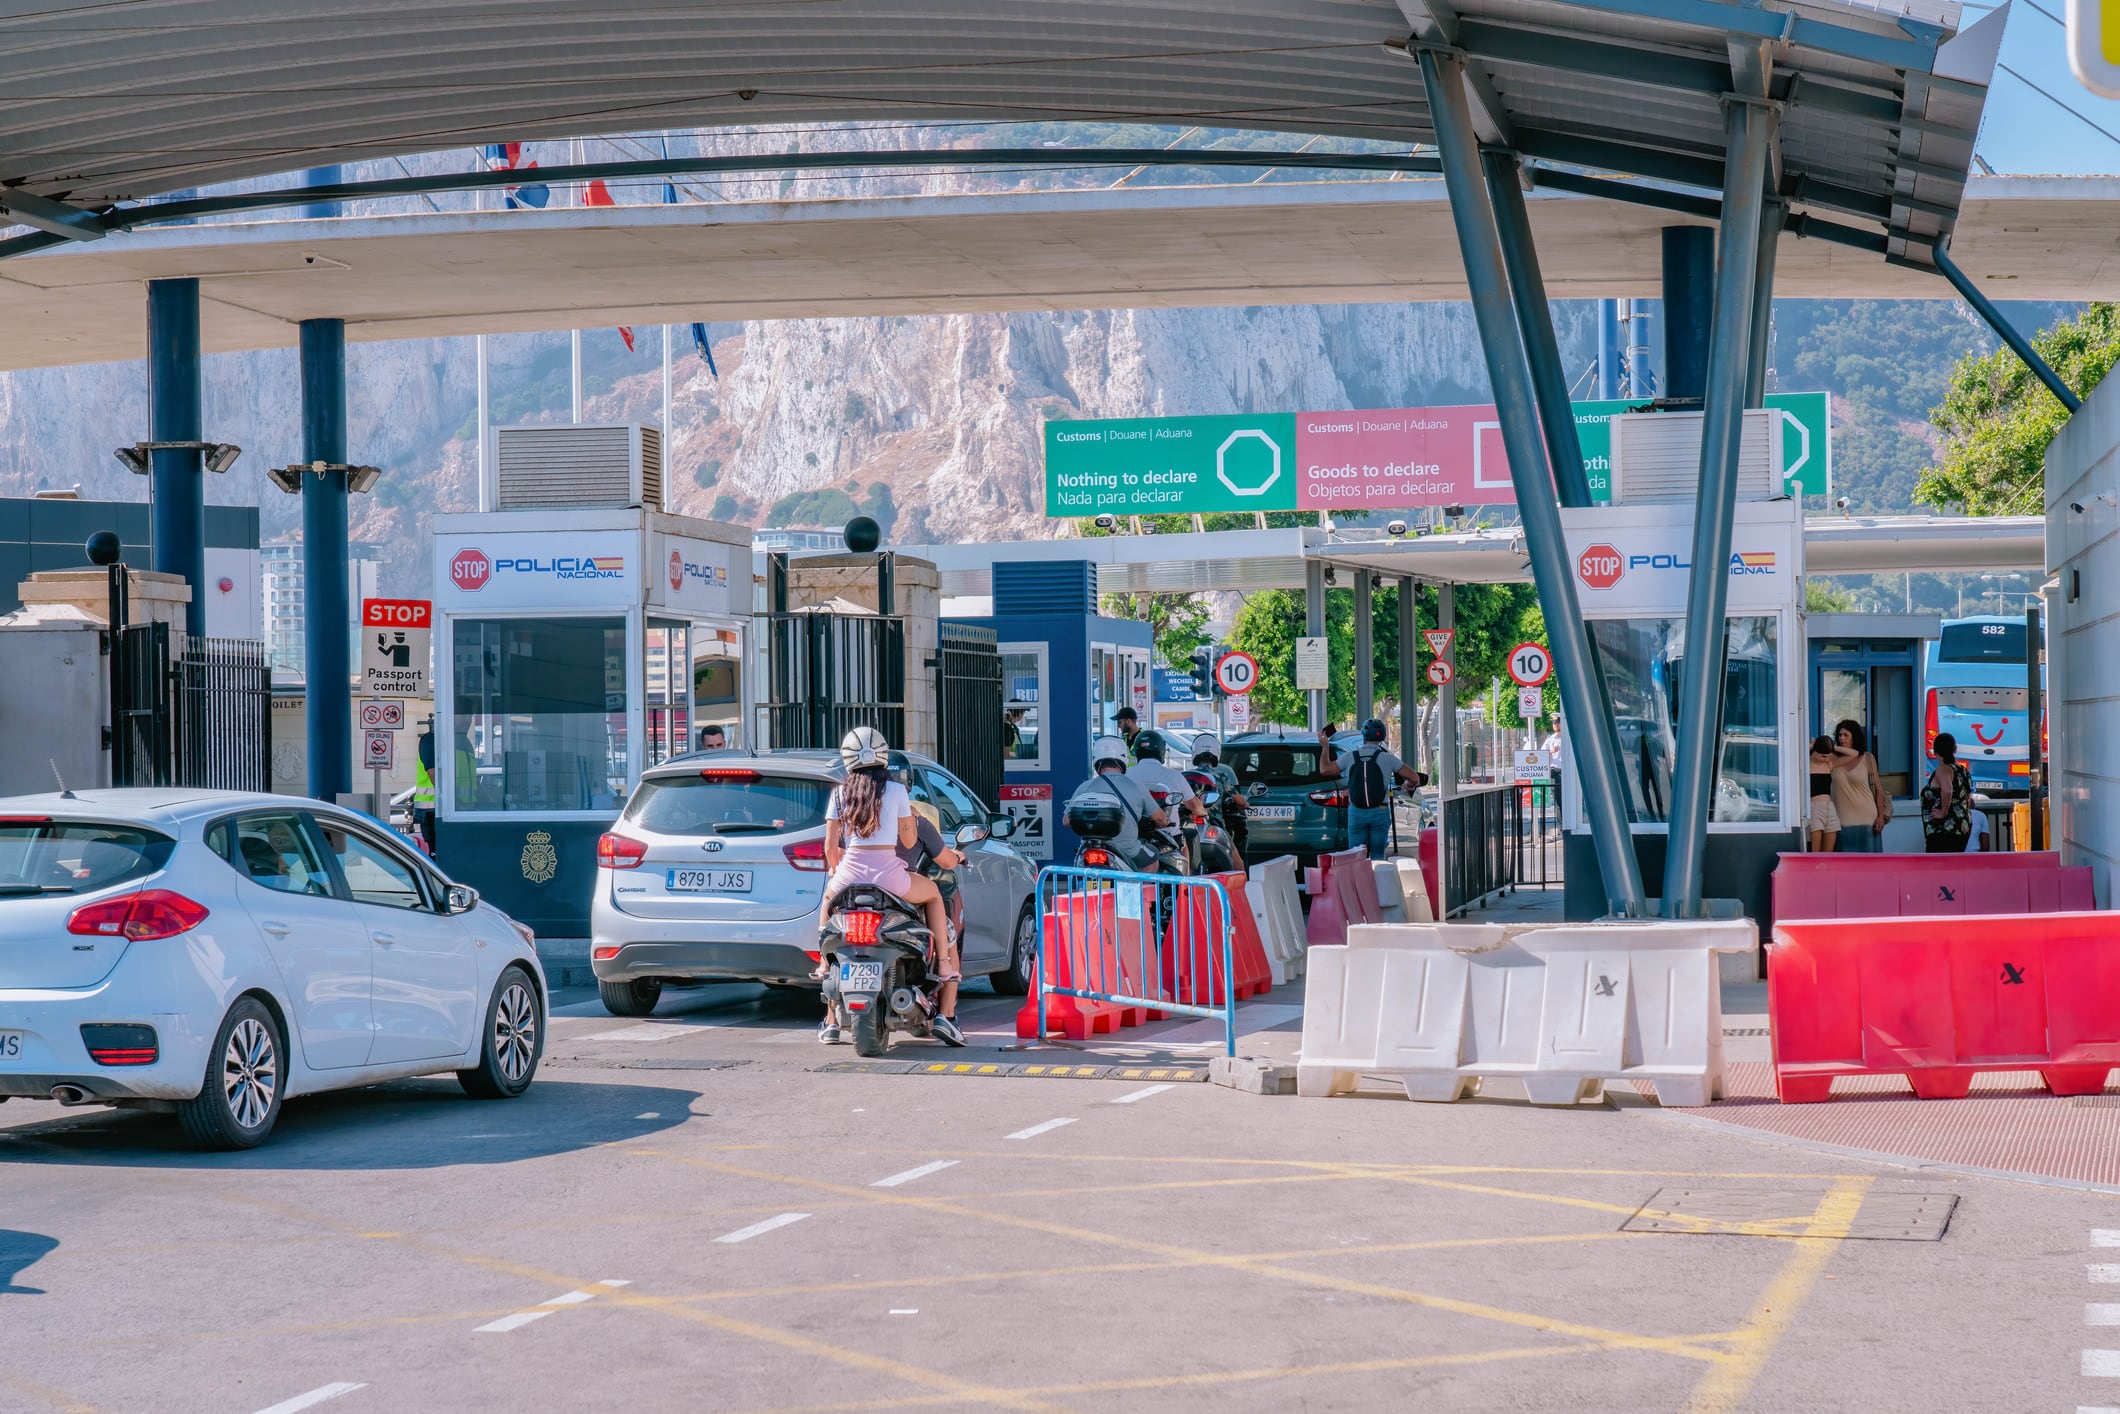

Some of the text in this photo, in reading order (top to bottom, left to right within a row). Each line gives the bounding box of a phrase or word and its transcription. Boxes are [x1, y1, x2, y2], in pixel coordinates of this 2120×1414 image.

[1307, 419, 1448, 433] Customs Douane Aduana
[1056, 428, 1192, 442] Customs Douane Aduana
[1308, 462, 1440, 479] Goods to declare
[1057, 470, 1197, 489] Nothing to declare
[1057, 488, 1184, 507] Nada para declarar
[1308, 480, 1456, 500] Objetos para declarar
[454, 560, 488, 579] STOP
[670, 561, 682, 579] STOP
[1582, 556, 1620, 576] STOP
[557, 570, 624, 579] NACIONAL
[369, 604, 426, 623] STOP
[1430, 633, 1449, 641] GIVE
[1981, 625, 2006, 635] 582
[1516, 655, 1543, 674] 10
[368, 668, 423, 681] Passport
[1224, 663, 1250, 682] 10
[373, 681, 417, 692] control
[1011, 787, 1040, 797] STOP
[704, 843, 721, 851] KIA
[678, 872, 744, 888] 8791 JXS
[851, 964, 880, 977] 7230
[854, 977, 876, 990] FPZ
